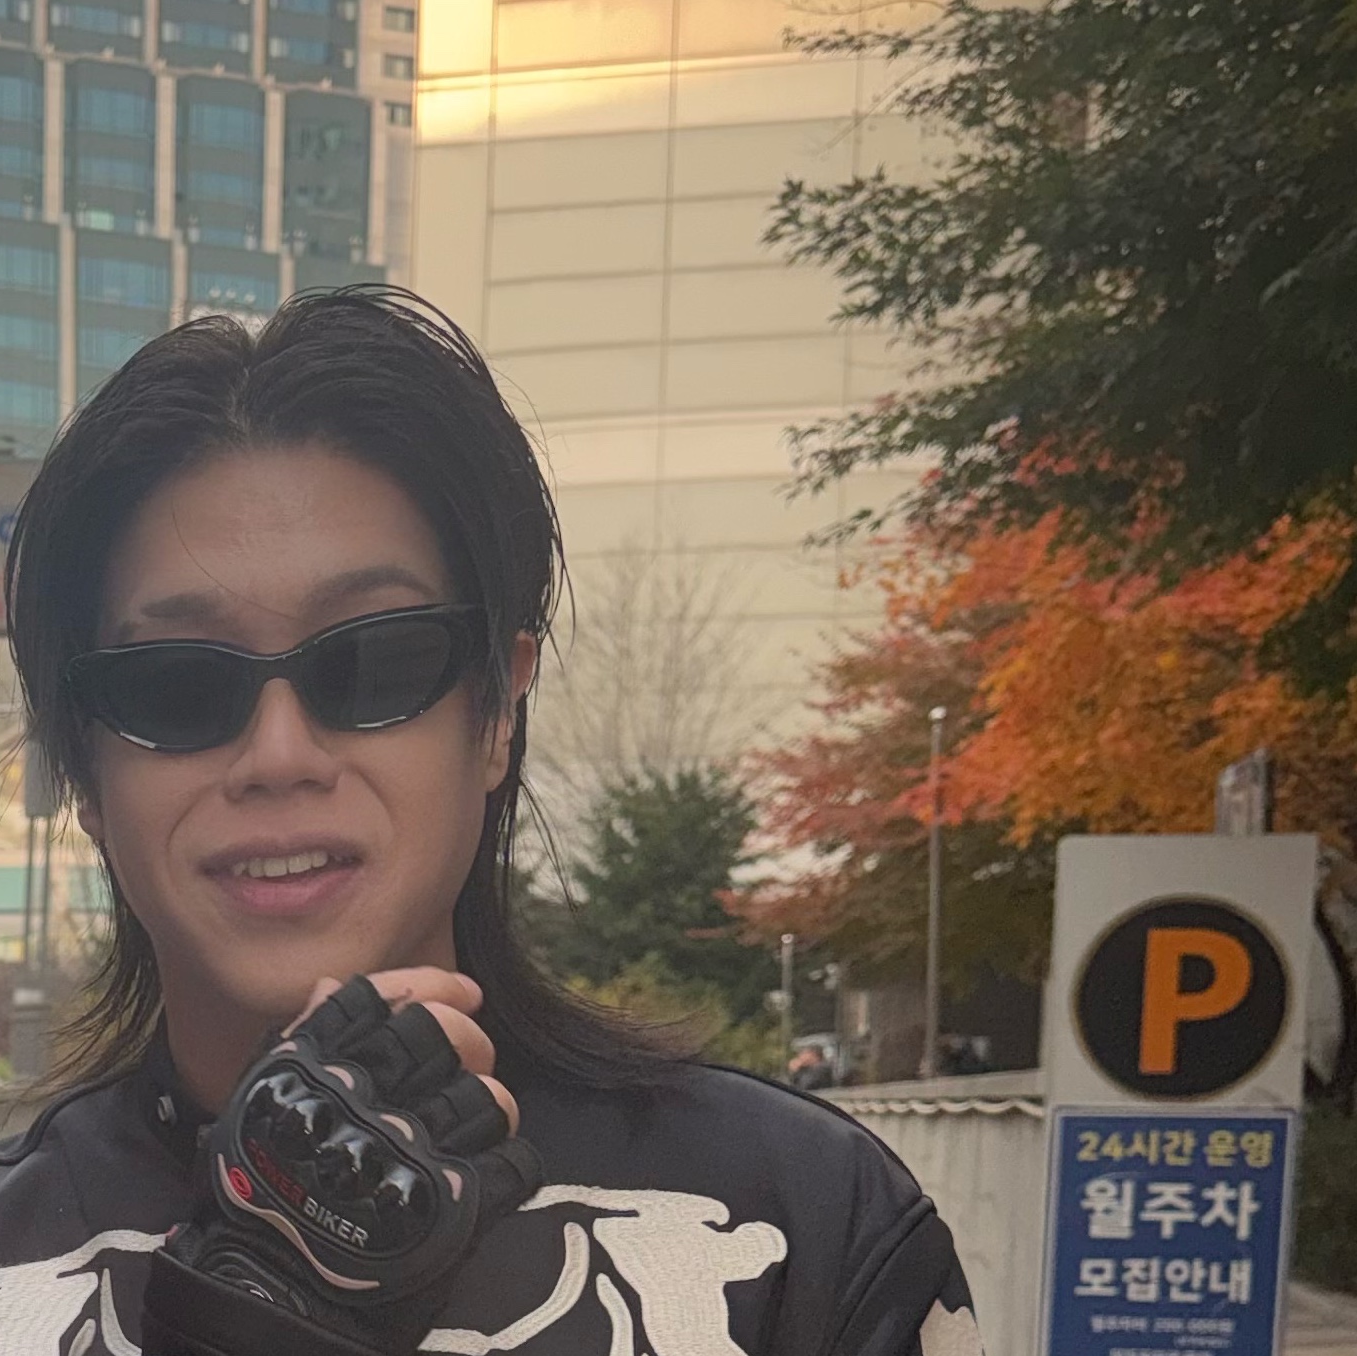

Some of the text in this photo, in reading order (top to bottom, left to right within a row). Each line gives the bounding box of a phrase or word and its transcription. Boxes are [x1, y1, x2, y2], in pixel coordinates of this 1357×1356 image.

[1139, 927, 1252, 1075] P
[1076, 1129, 1275, 1168] 24시간 운영
[302, 1195, 369, 1249] BIKER
[1080, 1177, 1262, 1241] 월주차
[1073, 1256, 1253, 1305] 모집안내
